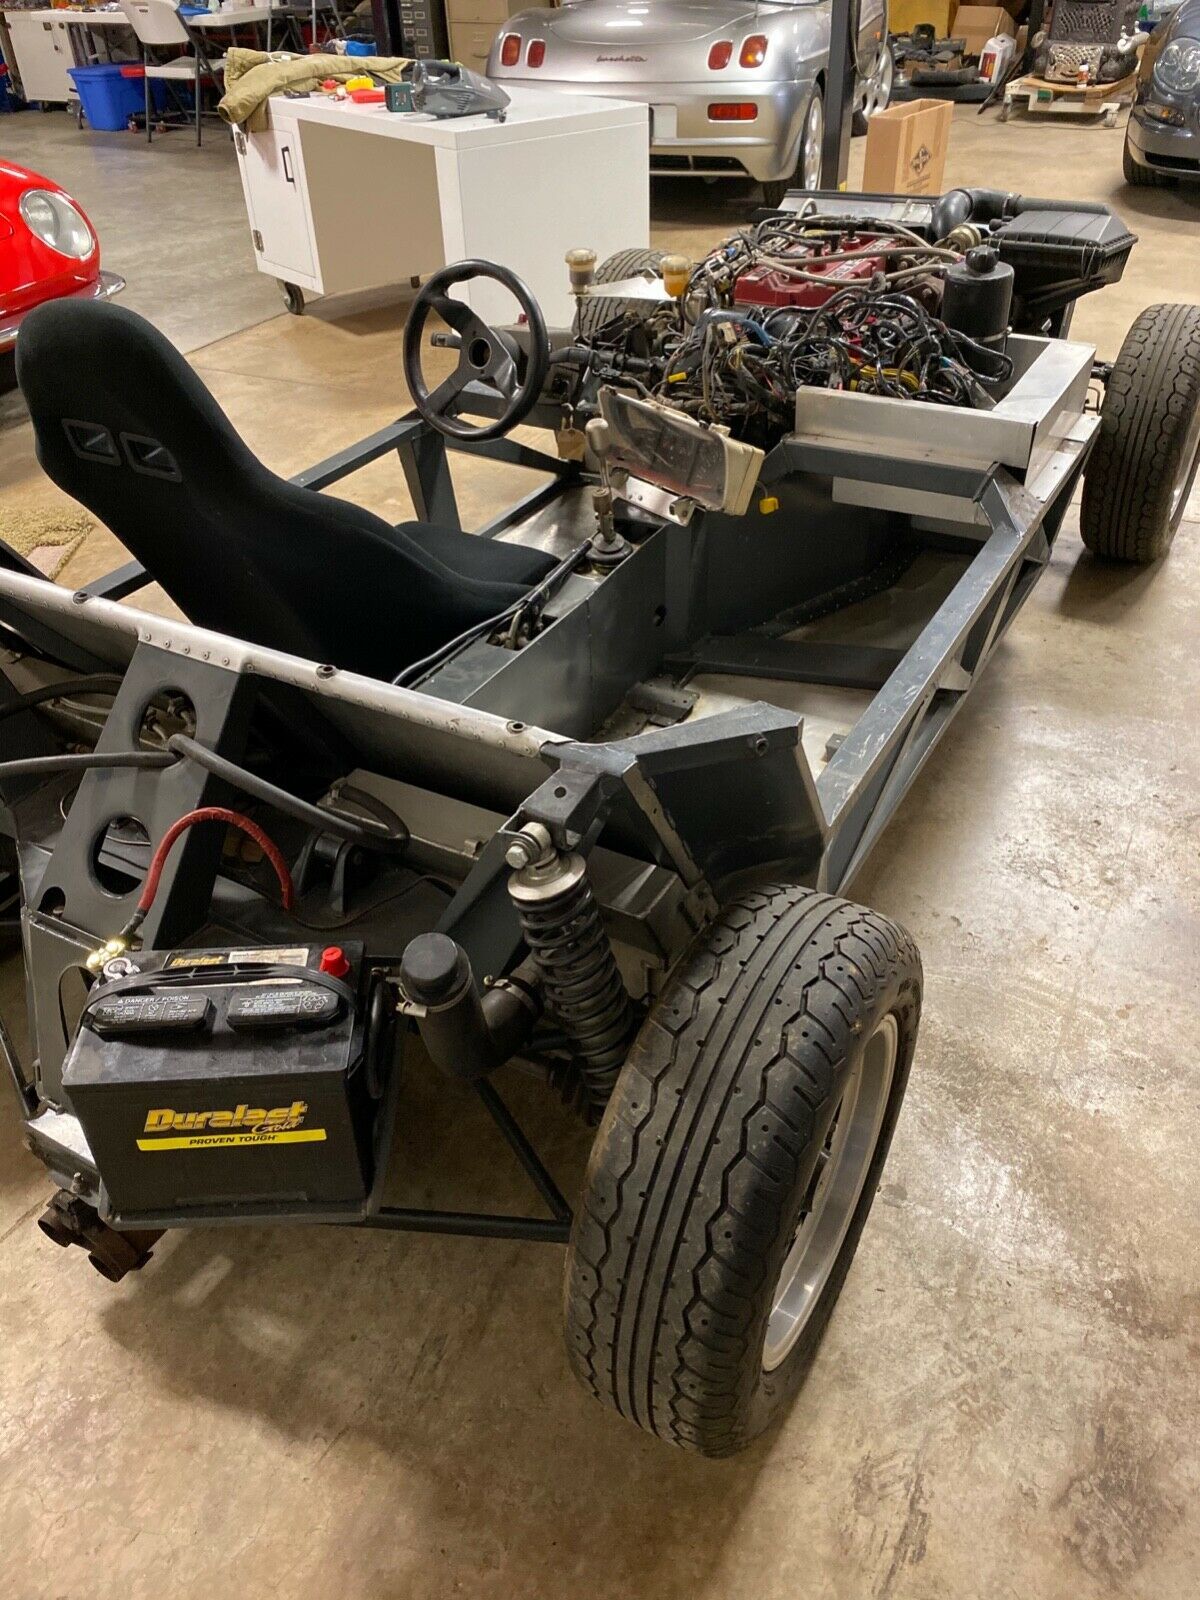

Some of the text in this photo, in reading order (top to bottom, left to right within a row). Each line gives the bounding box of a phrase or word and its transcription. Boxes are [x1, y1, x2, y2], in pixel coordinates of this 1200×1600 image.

[144, 1101, 308, 1132] Duralast
[251, 1121, 300, 1134] Gold
[189, 1136, 235, 1146] PROVEN
